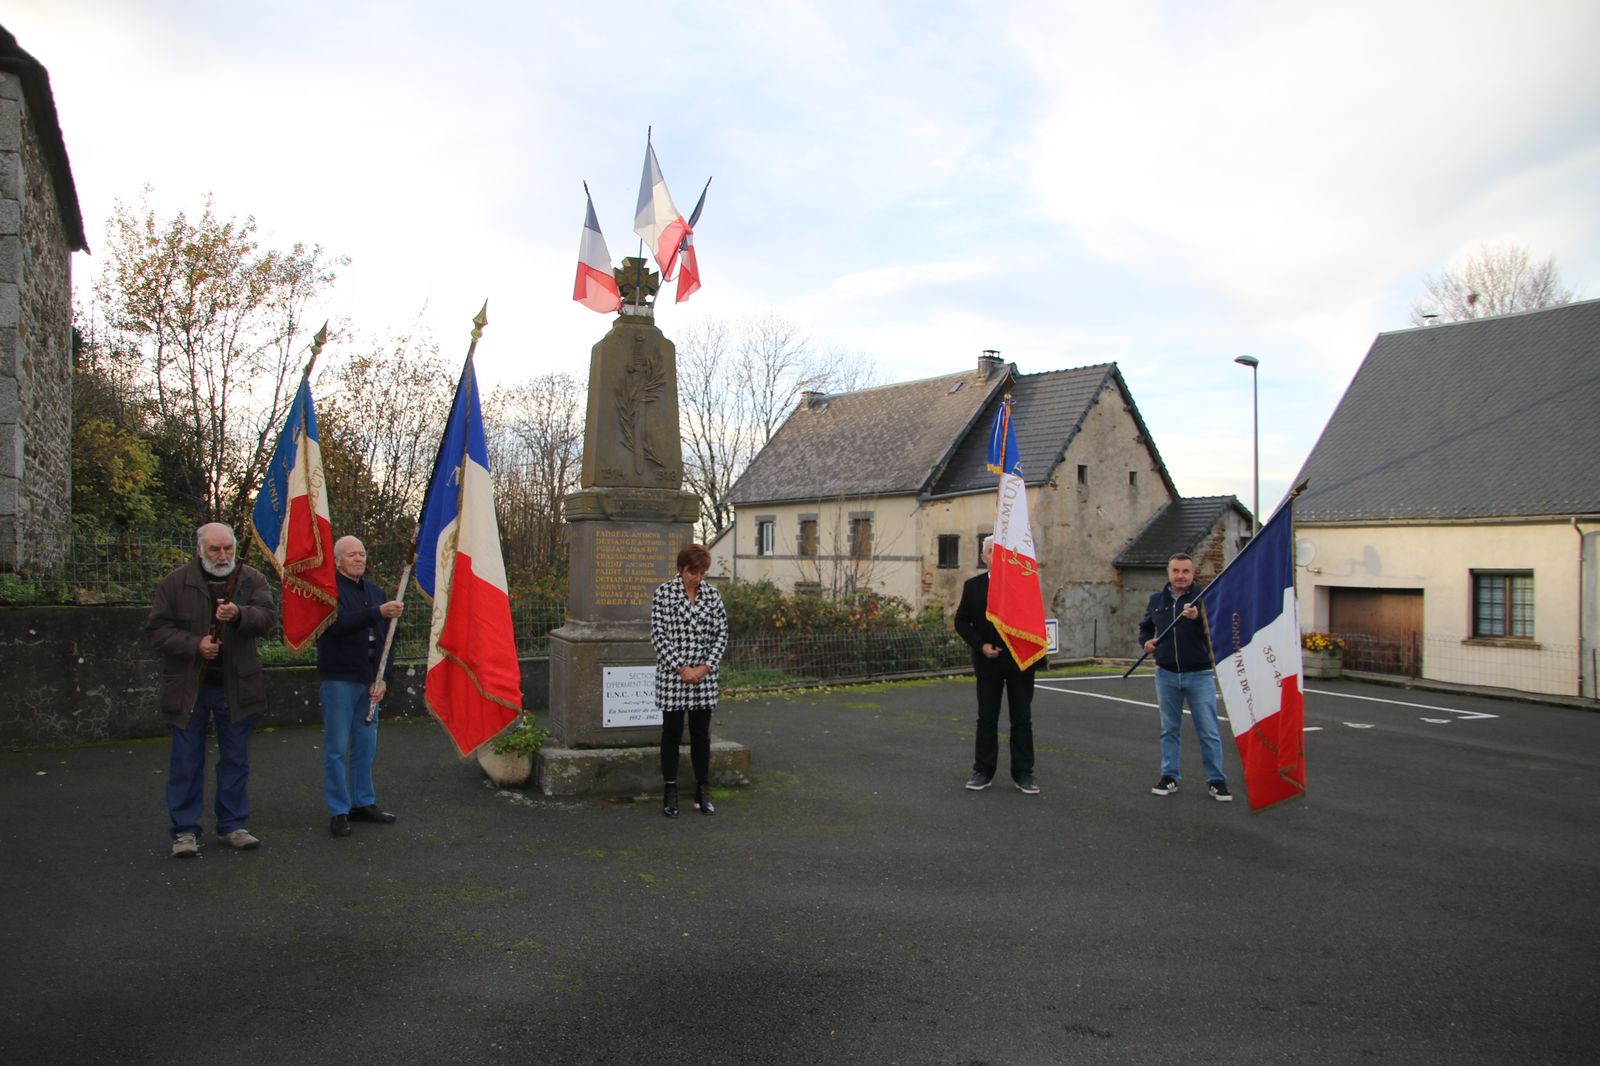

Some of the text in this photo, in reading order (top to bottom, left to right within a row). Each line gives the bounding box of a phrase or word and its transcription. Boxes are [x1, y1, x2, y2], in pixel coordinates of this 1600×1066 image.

[1001, 461, 1025, 563] COMMUNE
[1231, 612, 1251, 694] COMMUNE DE
